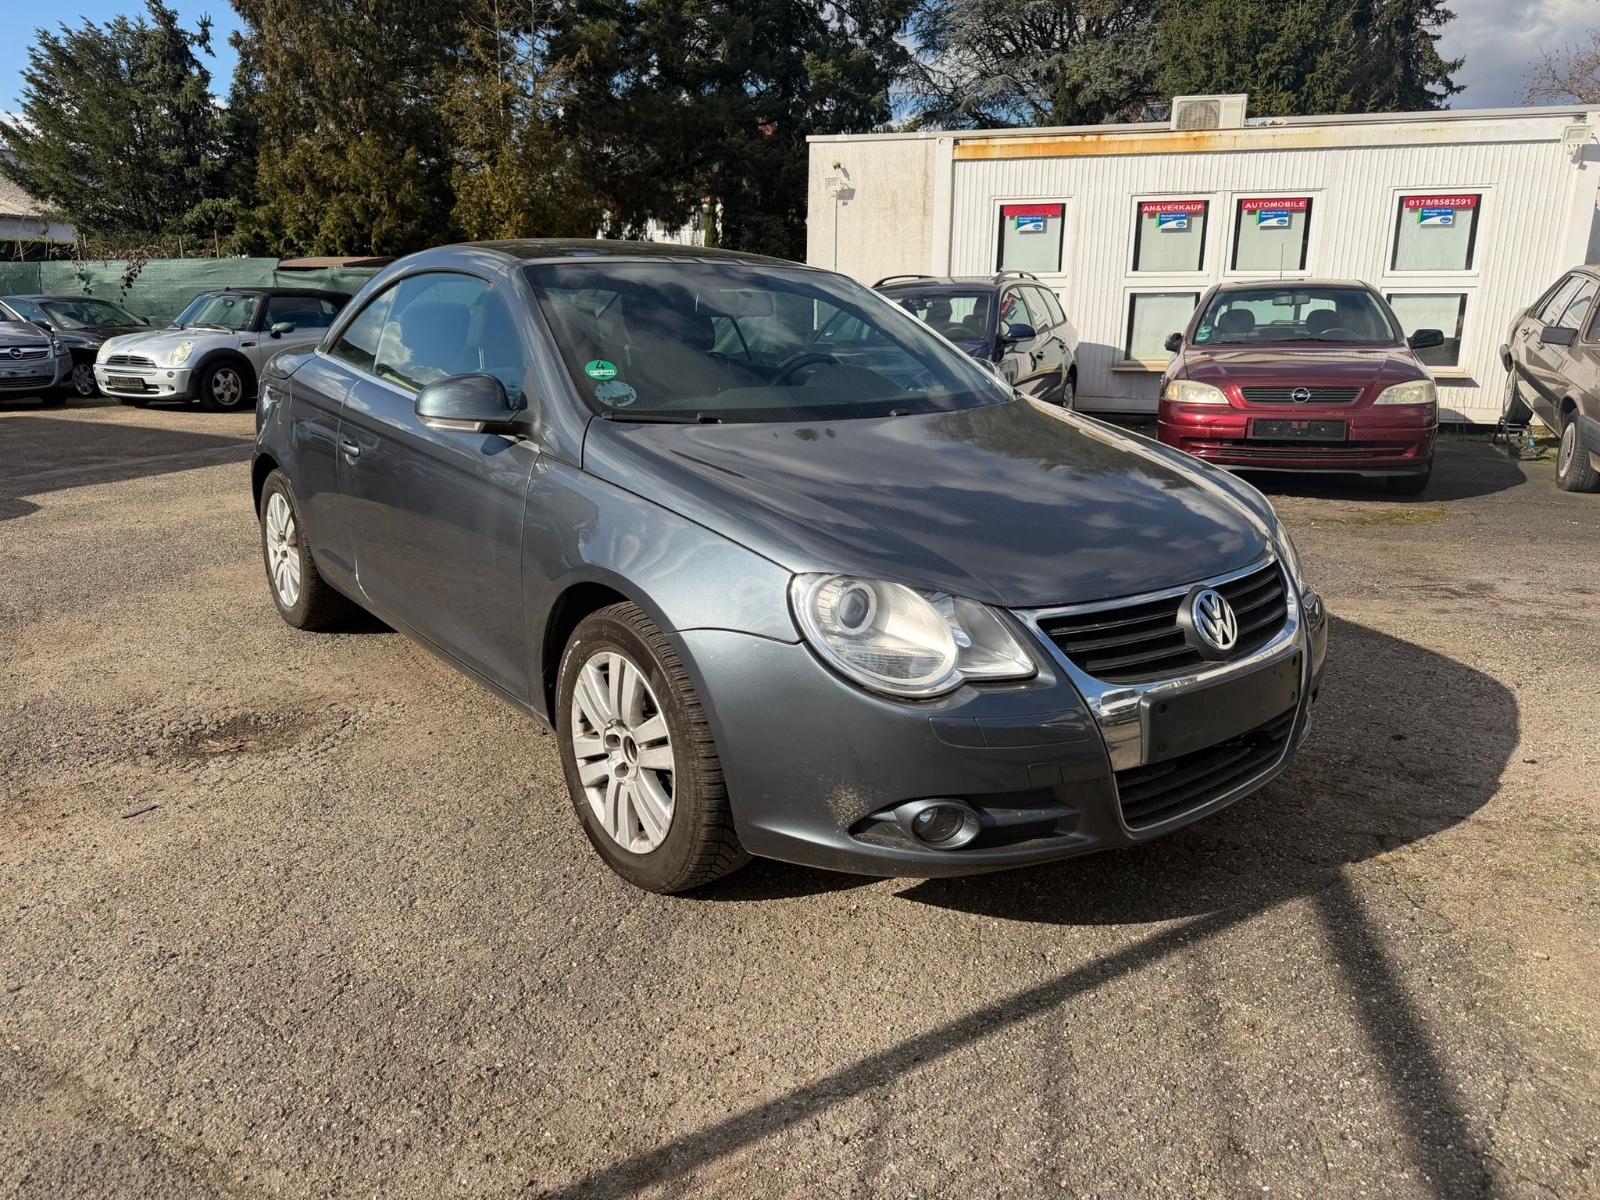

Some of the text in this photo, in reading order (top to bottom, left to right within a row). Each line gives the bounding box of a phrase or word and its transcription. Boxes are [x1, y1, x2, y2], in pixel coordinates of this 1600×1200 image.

[1244, 201, 1305, 209] AUTOMOBILE
[1408, 198, 1472, 206] 0178/8582591
[1143, 204, 1203, 212] AN&VERKAUF
[595, 361, 605, 370] 4
